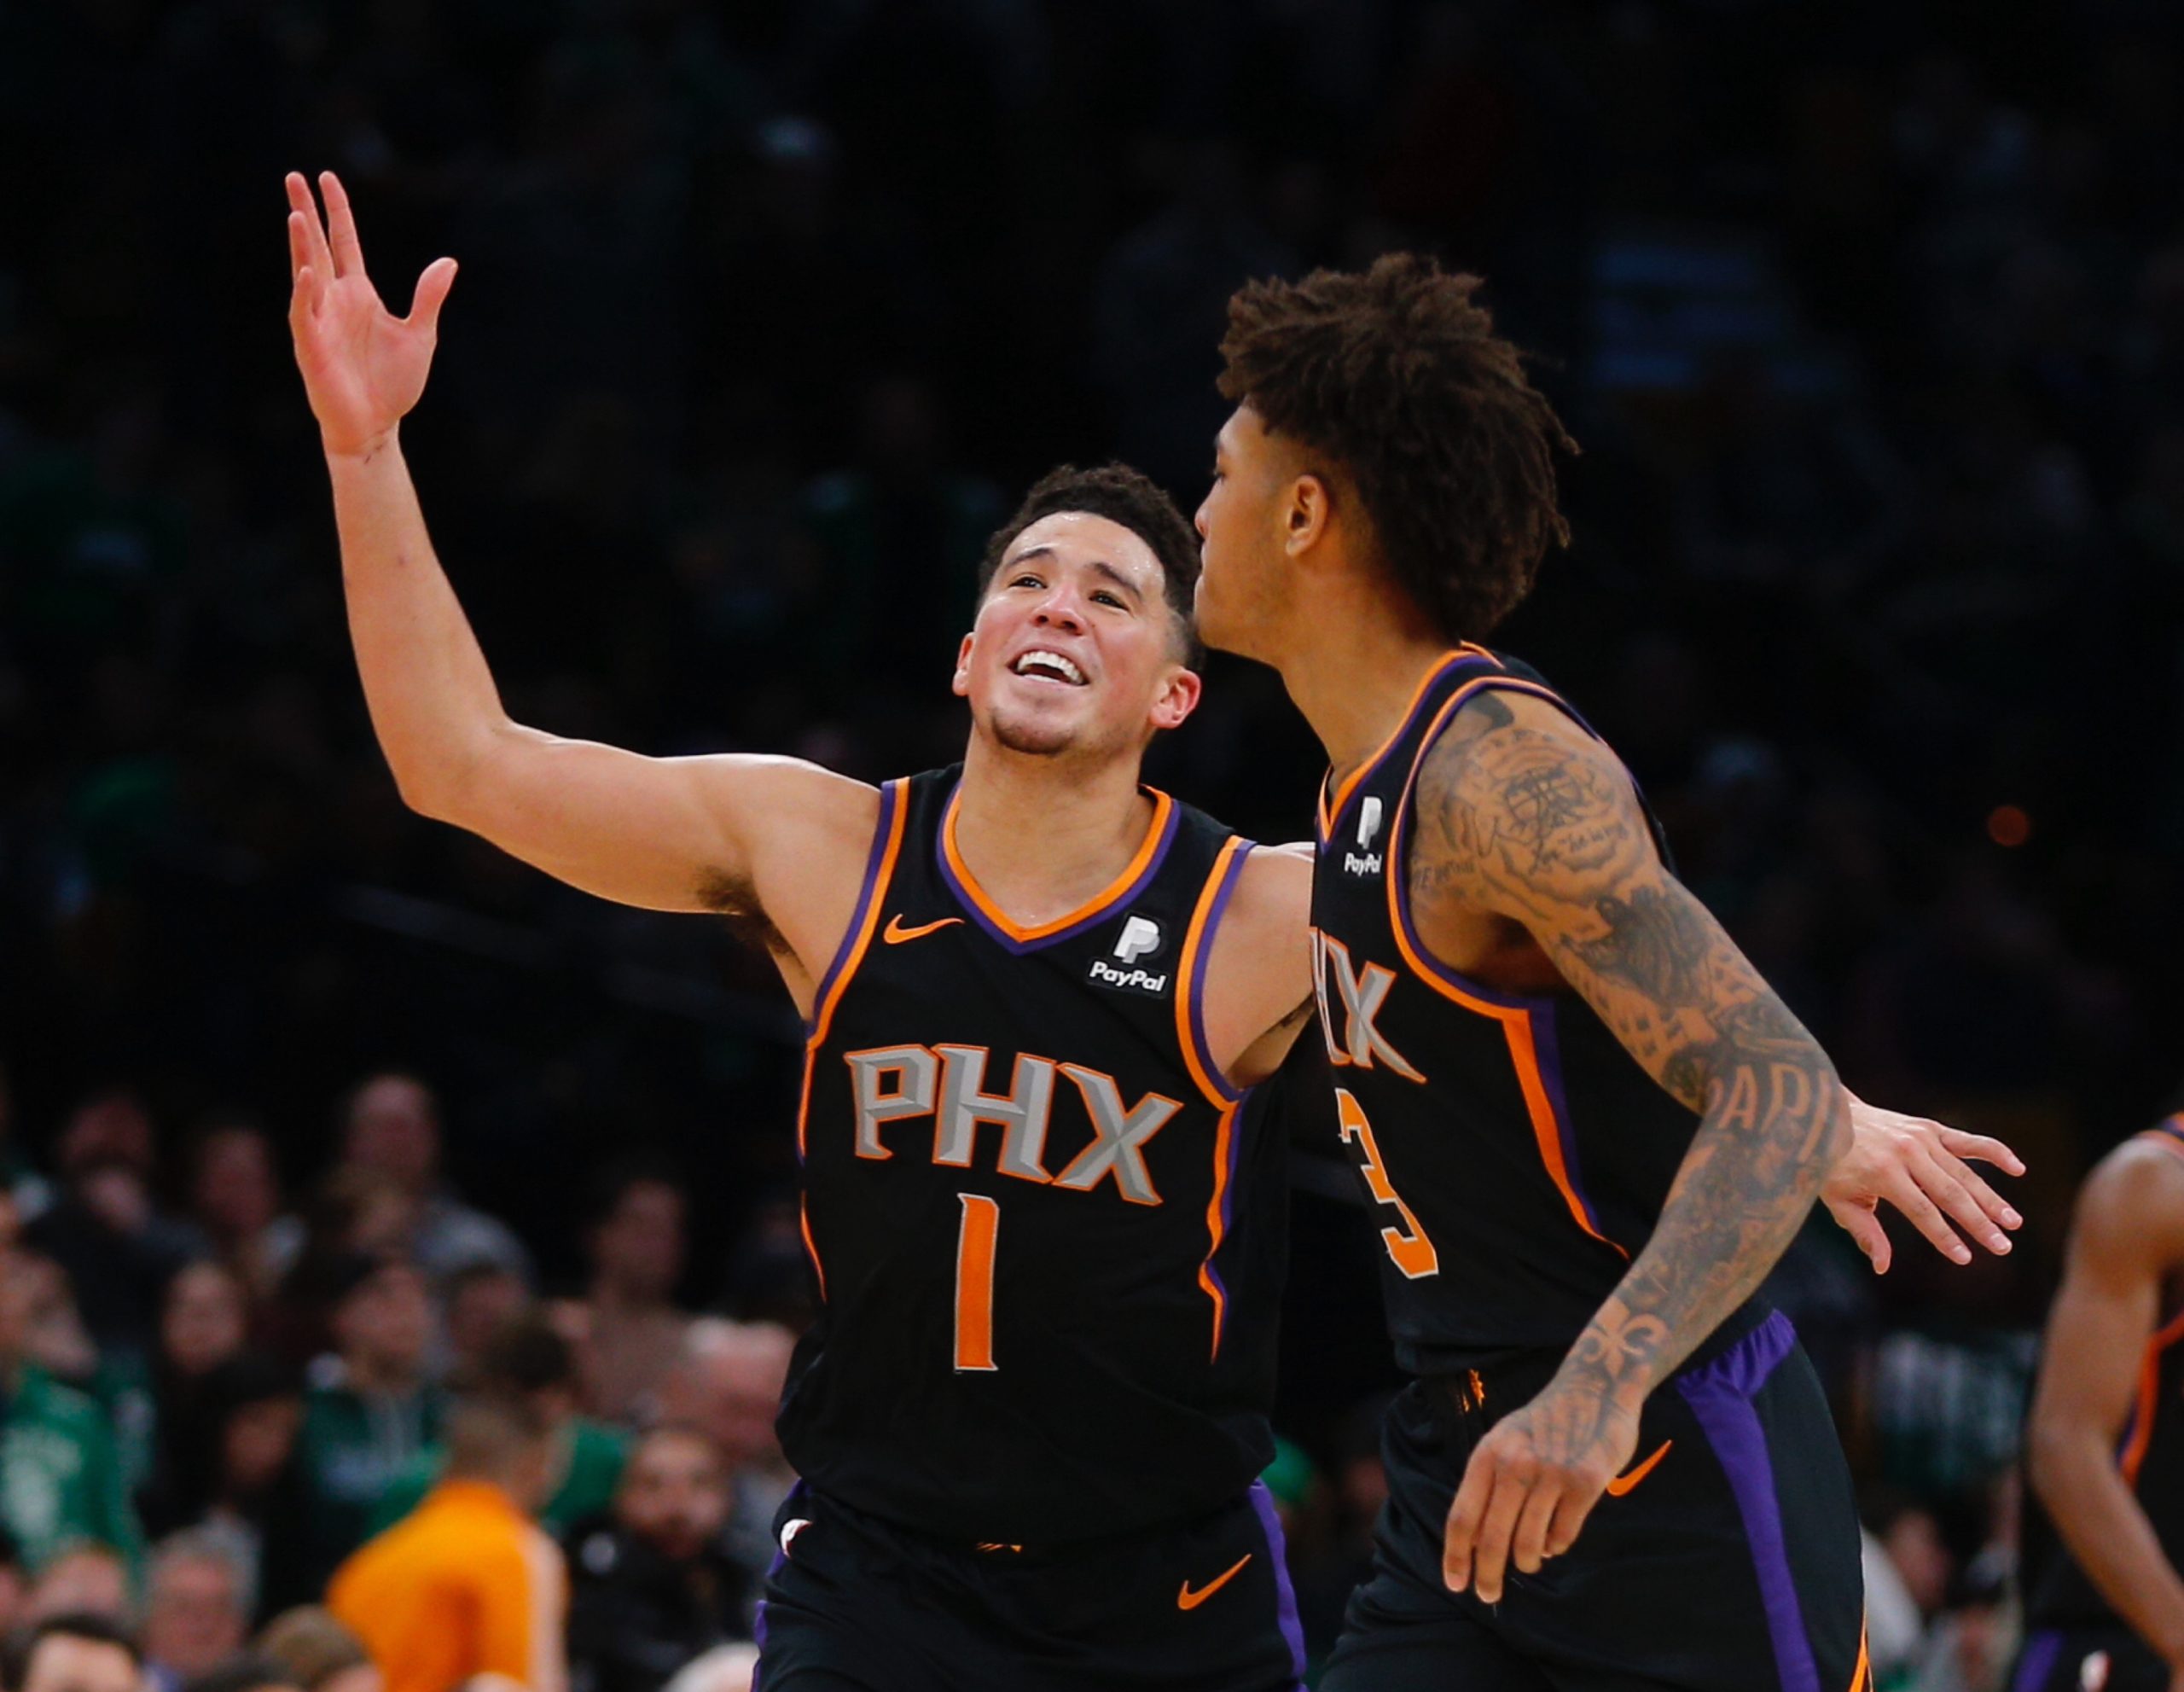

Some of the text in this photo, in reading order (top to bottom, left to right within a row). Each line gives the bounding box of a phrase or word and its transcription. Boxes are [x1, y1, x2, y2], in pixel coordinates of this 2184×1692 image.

[1344, 852, 1382, 876] PayPal
[1089, 961, 1166, 991] PayPal
[843, 1043, 1185, 1206] PHX
[1335, 1087, 1439, 1279] 3
[954, 1192, 999, 1371] 1
